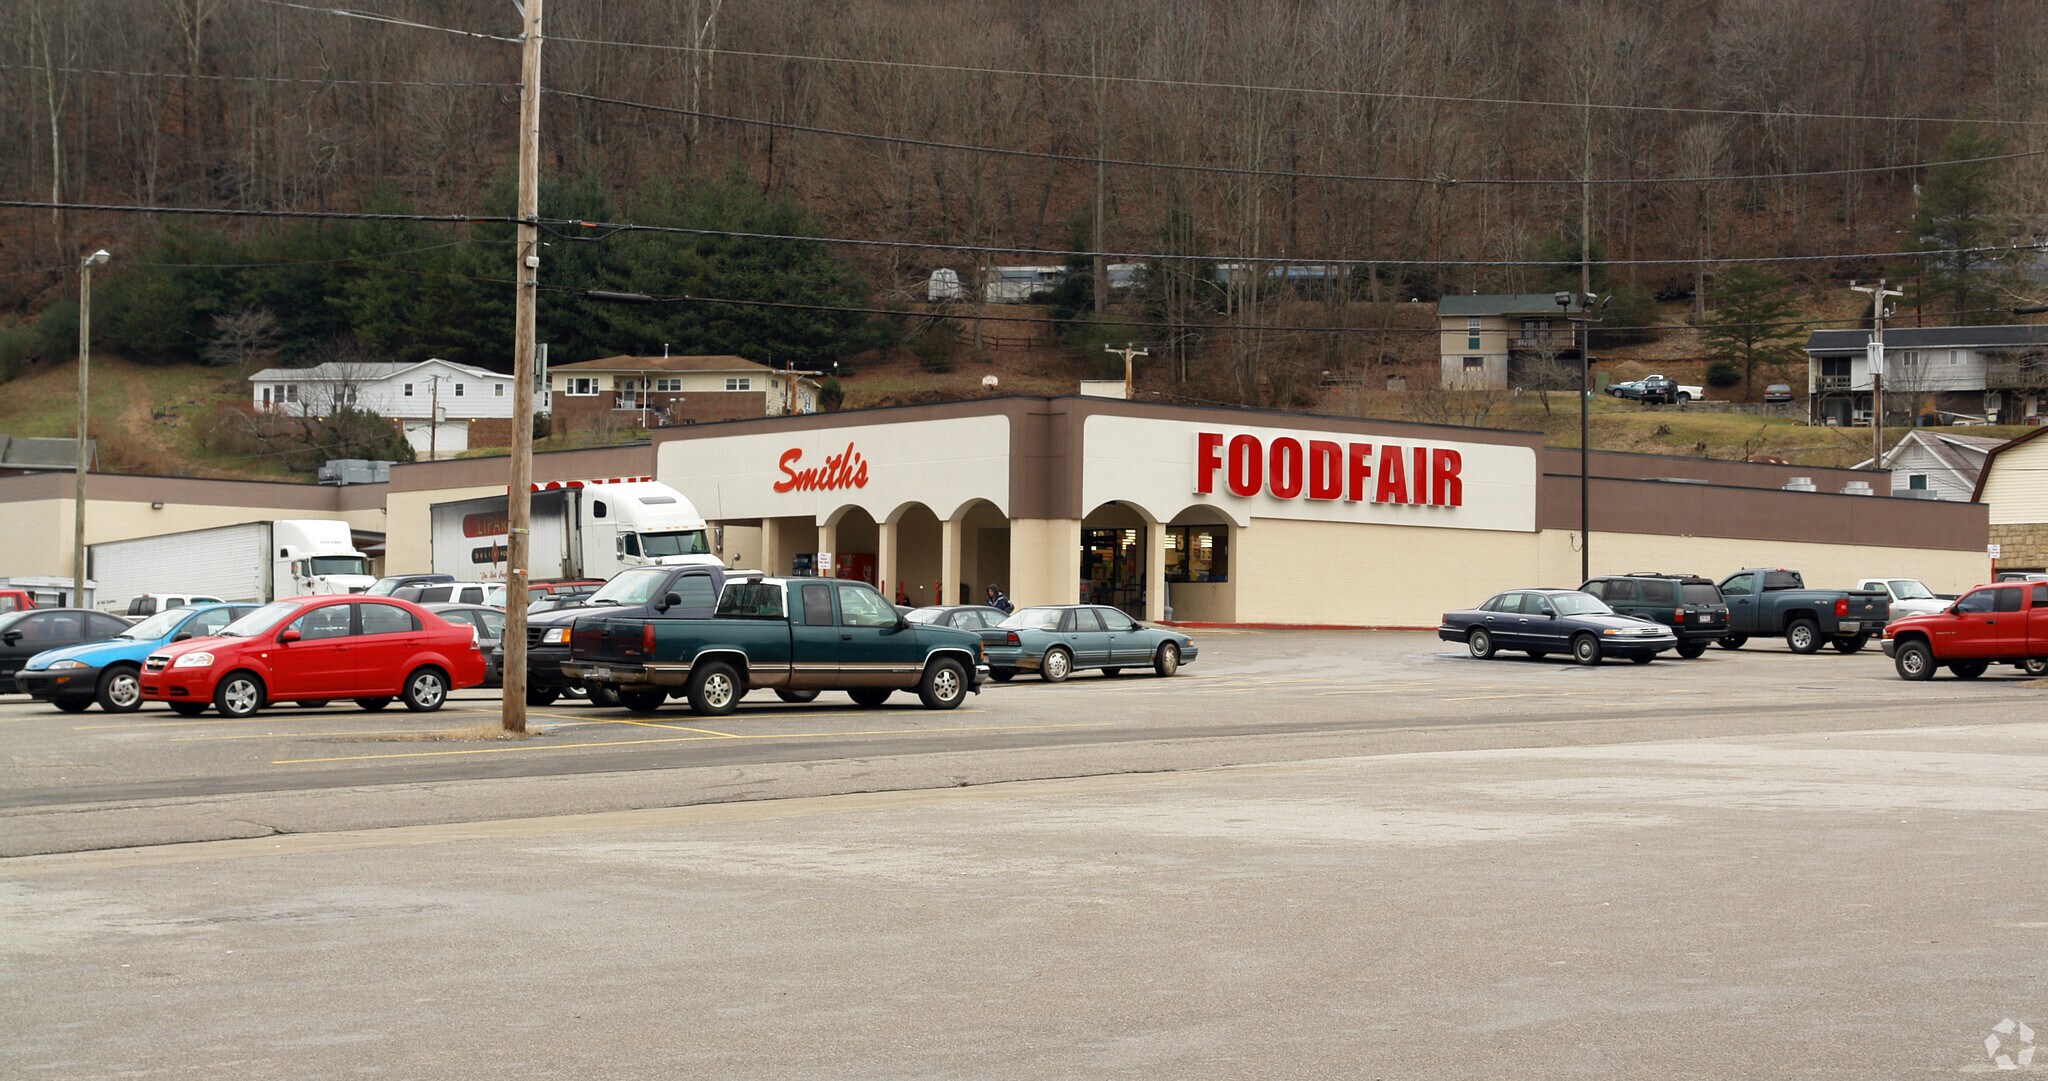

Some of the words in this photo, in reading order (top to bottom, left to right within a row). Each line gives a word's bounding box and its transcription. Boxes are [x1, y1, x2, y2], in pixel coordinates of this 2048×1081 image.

[773, 441, 868, 493] Smith's
[1193, 432, 1463, 507] FOODFAIR
[477, 516, 508, 534] LIPAR
